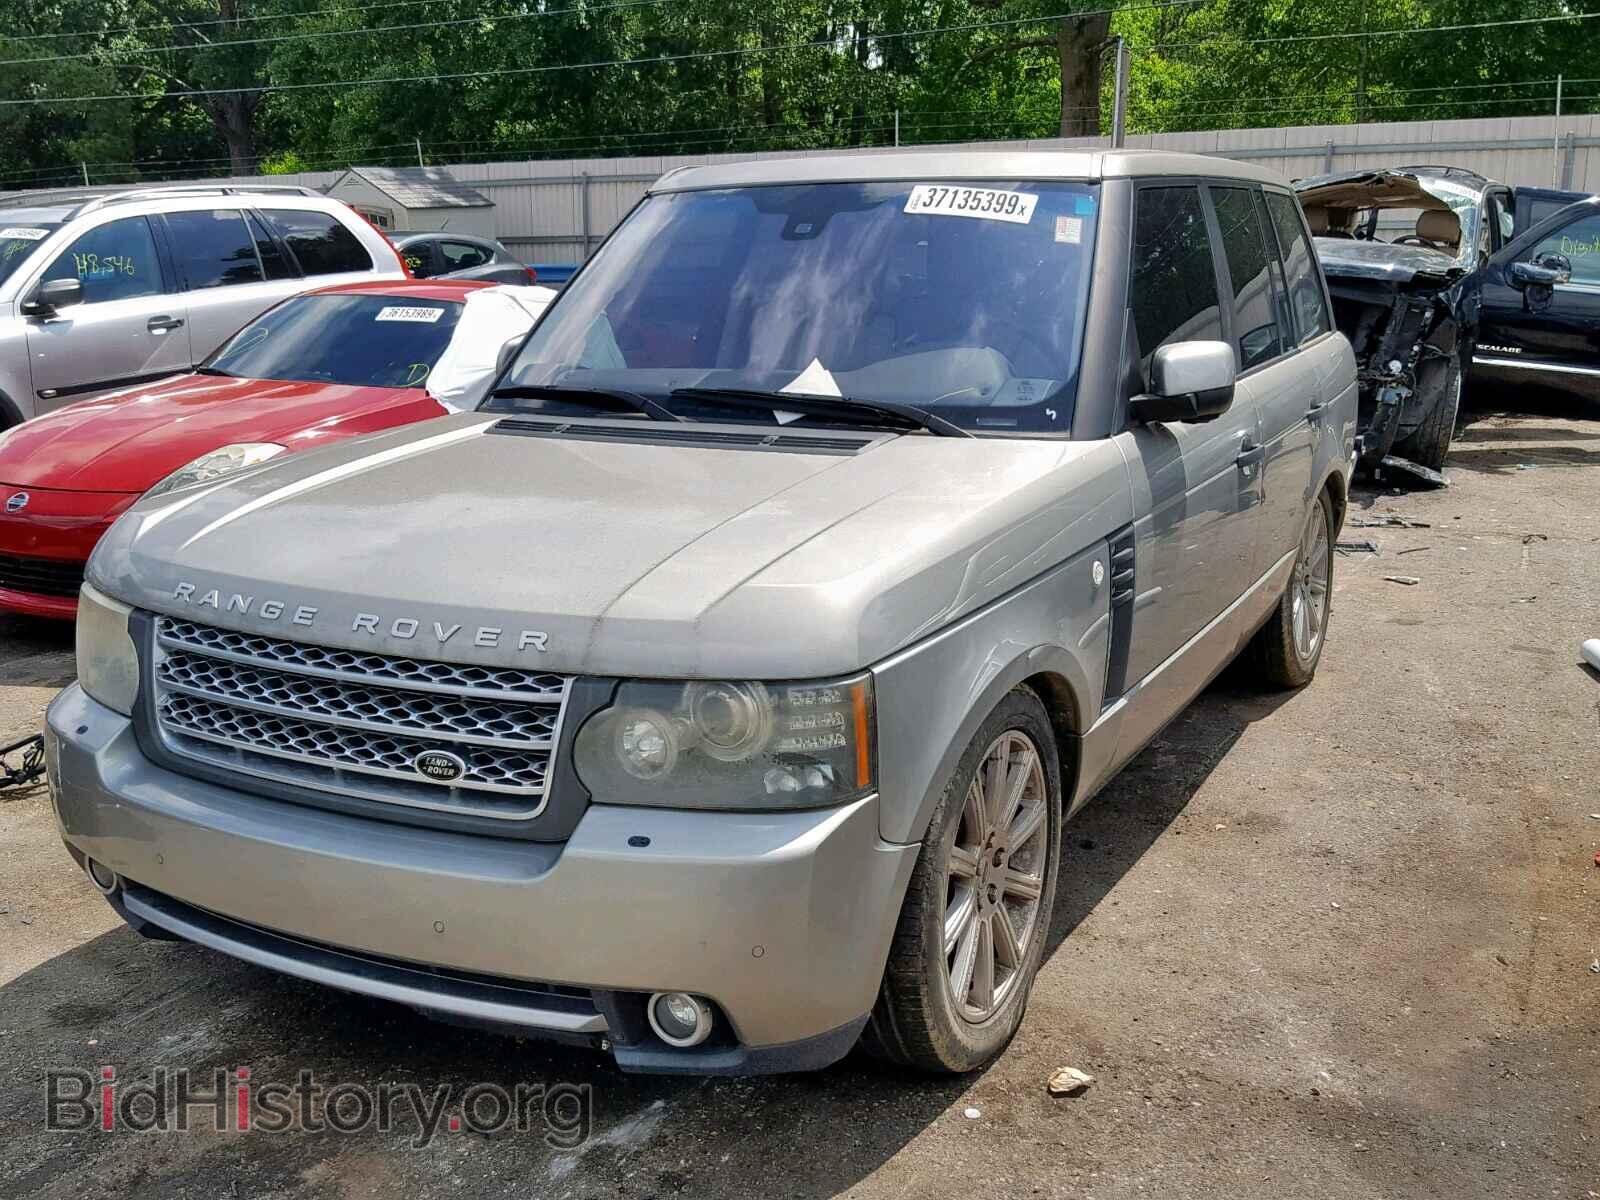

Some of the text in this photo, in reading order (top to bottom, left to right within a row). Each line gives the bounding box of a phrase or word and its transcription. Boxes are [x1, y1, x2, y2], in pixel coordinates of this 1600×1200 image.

[1476, 343, 1522, 353] SCALADE
[172, 581, 549, 652] RANGE ROVER
